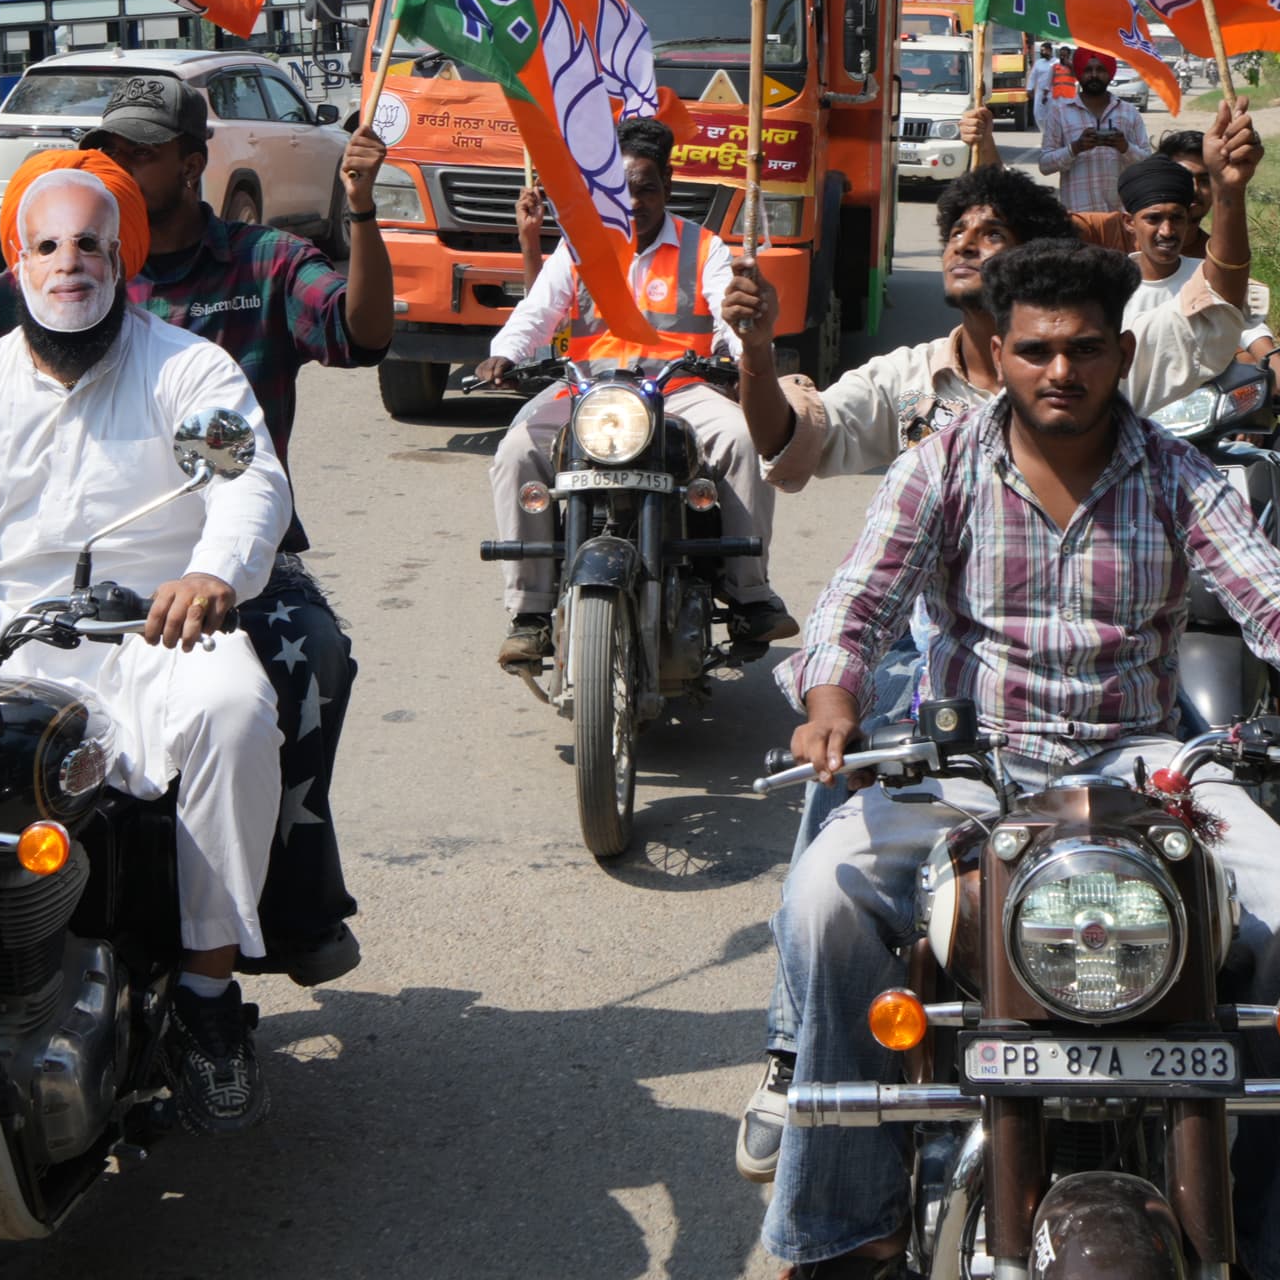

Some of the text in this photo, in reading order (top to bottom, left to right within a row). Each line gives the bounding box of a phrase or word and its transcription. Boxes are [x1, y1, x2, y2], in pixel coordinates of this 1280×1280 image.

[417, 111, 450, 126] ਭਾਰਤੀ
[453, 117, 484, 130] ਜਨਤਾ
[452, 131, 484, 149] ਪੰਜਾਬ
[707, 126, 726, 139] ਦਾ
[768, 159, 797, 171] ਸਾਰਾ
[571, 472, 669, 490] PB 05AP 7151
[1003, 1046, 1228, 1076] PB 87A 2383
